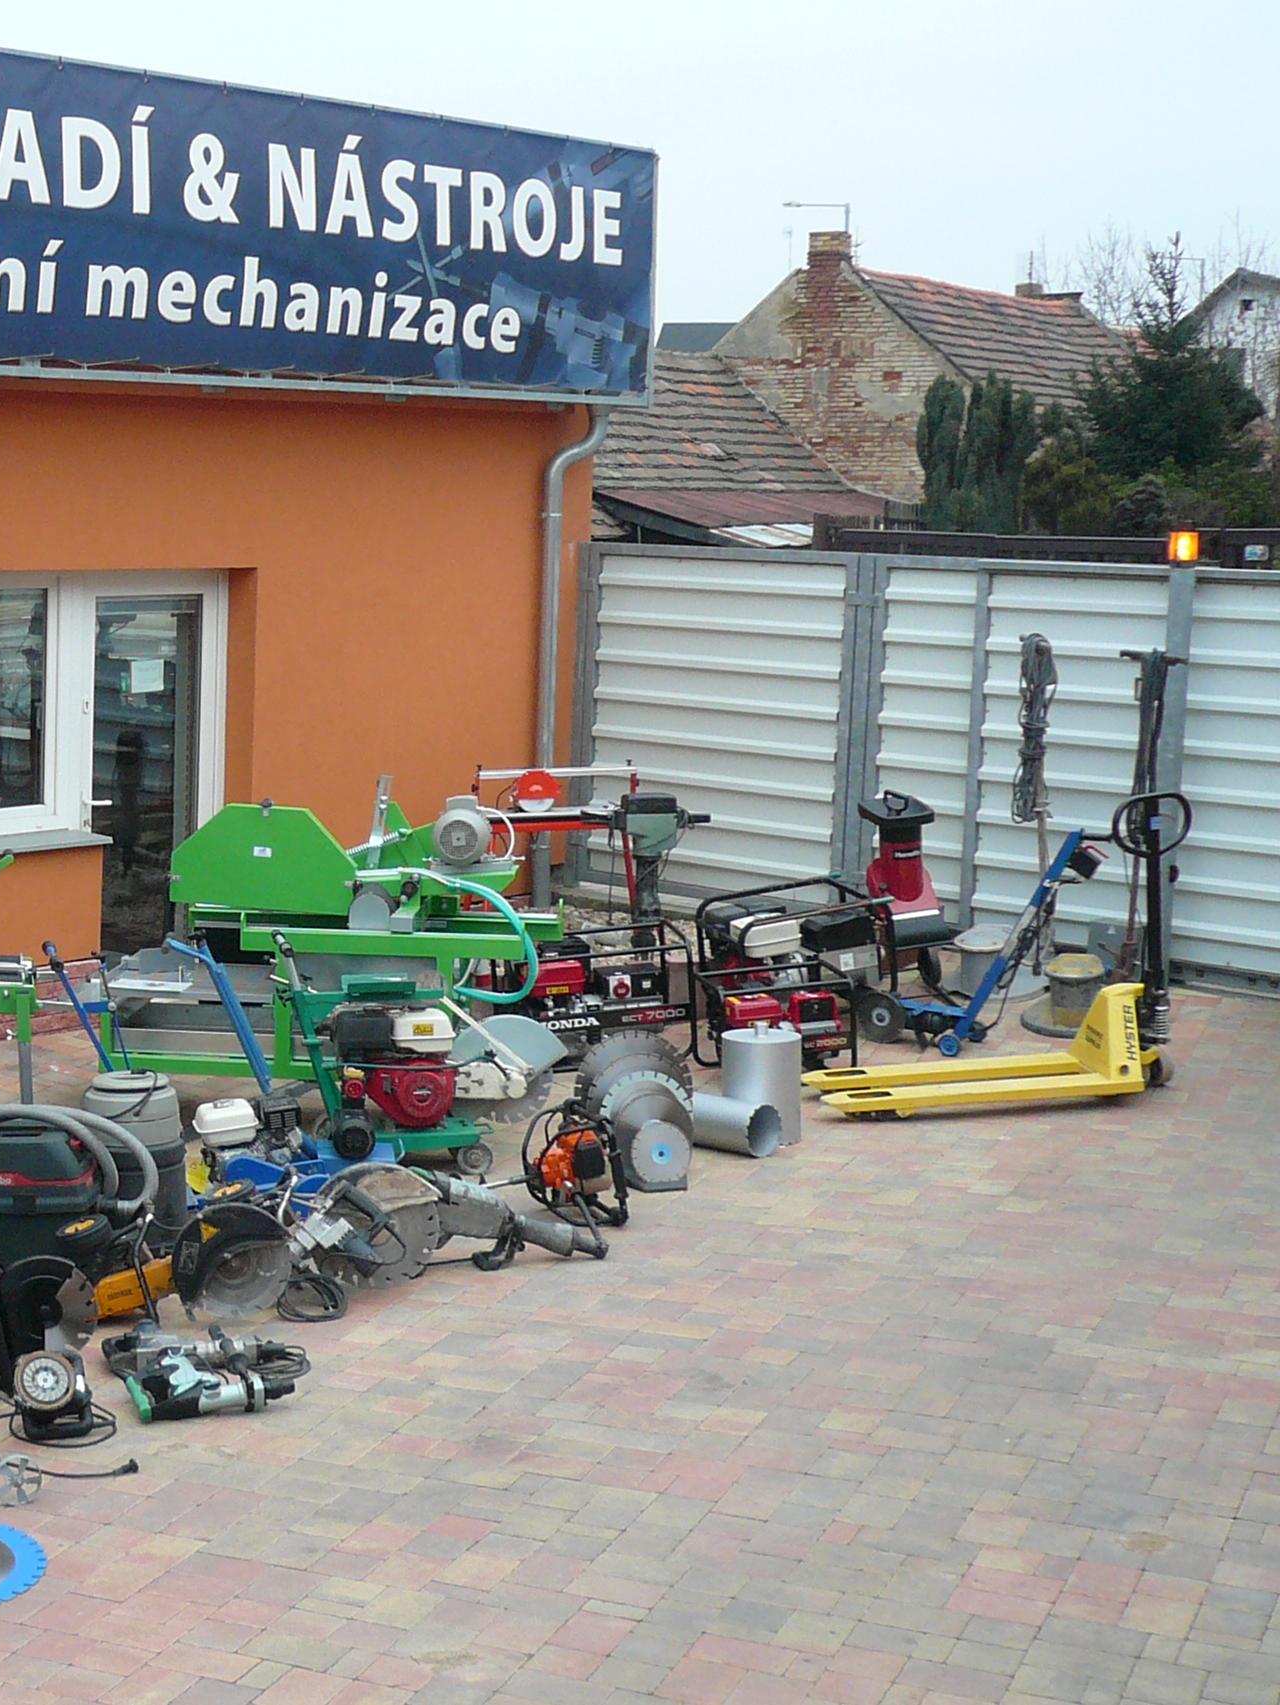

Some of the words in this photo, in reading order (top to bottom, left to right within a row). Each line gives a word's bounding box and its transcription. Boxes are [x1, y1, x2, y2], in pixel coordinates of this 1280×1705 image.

[183, 132, 240, 225] &
[267, 134, 624, 267] NÁSTROJE
[85, 256, 521, 354] mechanizace
[646, 1007, 686, 1020] 7000
[1122, 1004, 1137, 1061] HYSTER
